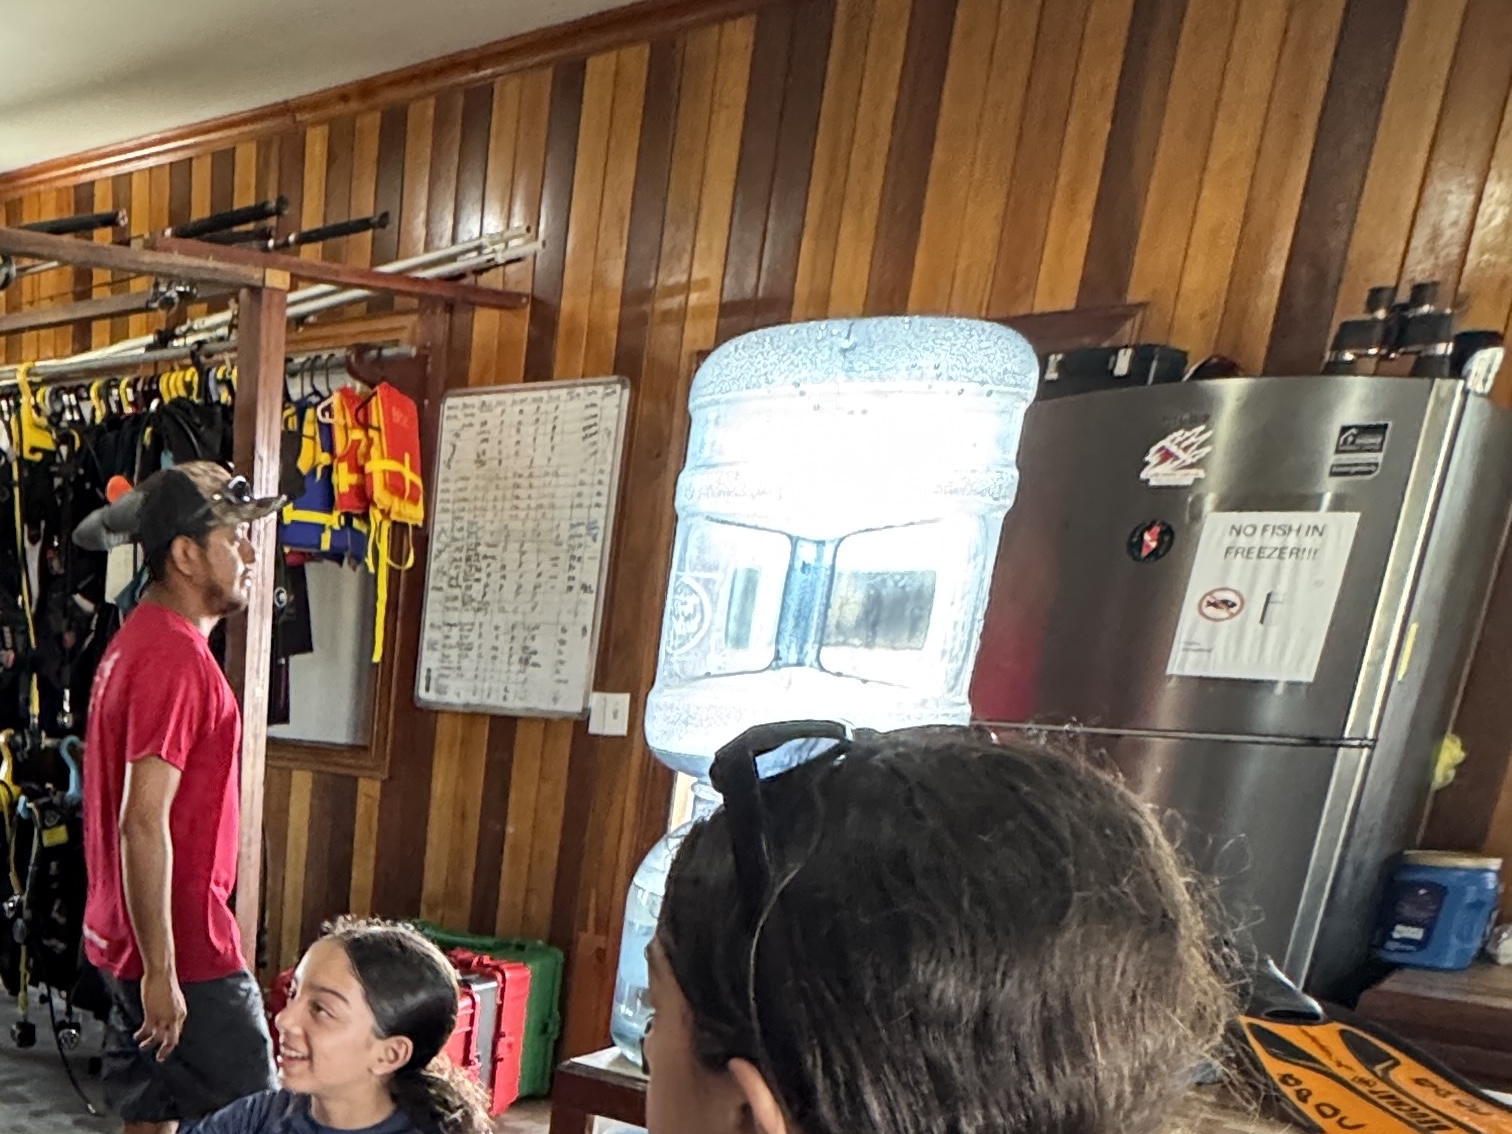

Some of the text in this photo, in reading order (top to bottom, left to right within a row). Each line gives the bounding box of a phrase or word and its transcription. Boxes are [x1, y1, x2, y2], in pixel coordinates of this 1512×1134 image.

[1229, 523, 1327, 538] NO FISH IN
[1223, 546, 1319, 561] FREEZER!!!
